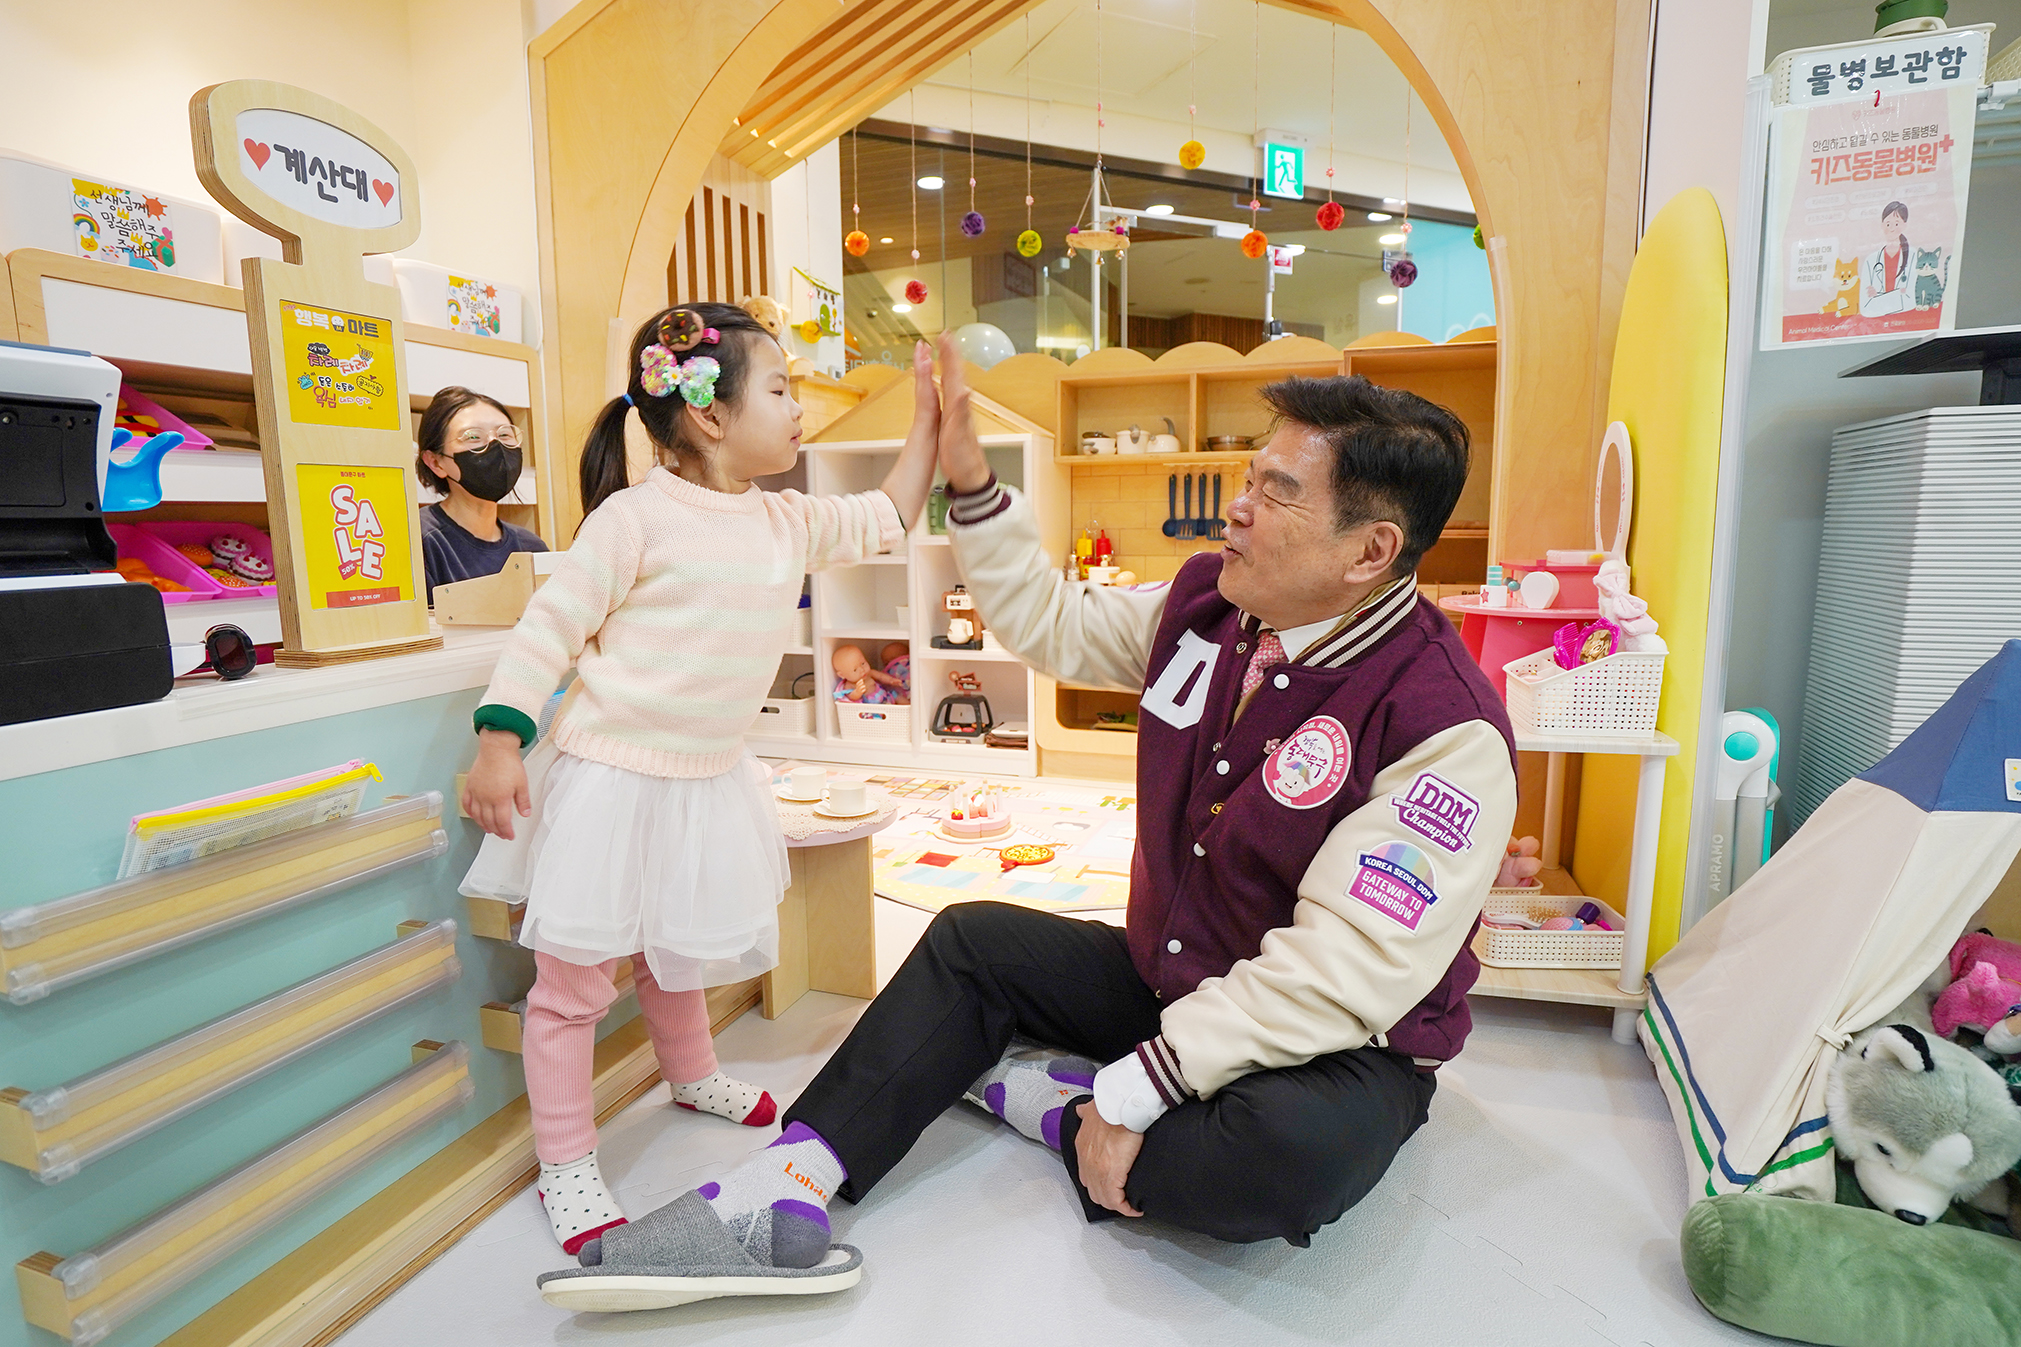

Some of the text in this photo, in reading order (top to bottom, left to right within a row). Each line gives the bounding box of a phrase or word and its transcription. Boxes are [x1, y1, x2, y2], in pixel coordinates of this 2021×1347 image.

[1807, 46, 1967, 96] 물병보관함
[1812, 136, 1848, 153] 안심하고
[1870, 134, 1879, 144] 수
[1882, 130, 1900, 143] 있는
[1902, 124, 1939, 141] 동물병원
[273, 143, 369, 203] 계산대
[1810, 141, 1939, 185] 키즈동물병원
[90, 189, 150, 218] 선생님께
[116, 239, 158, 258] 주세요
[294, 309, 380, 338] 행복 마트
[1788, 322, 1850, 335] Animal Medical Center
[307, 352, 367, 374] 차례 차례
[330, 484, 385, 580] SALE
[341, 564, 355, 575] 50%
[1329, 773, 1339, 783] 곳
[1333, 757, 1345, 773] 여는
[1415, 781, 1474, 834] DDM
[1403, 808, 1458, 848] Champion
[1364, 857, 1433, 900] KOREA SEOUL DDM
[1709, 834, 1724, 892] APRAMO
[1359, 882, 1415, 921] TOMORROW
[1362, 870, 1423, 911] GATEWAY TO
